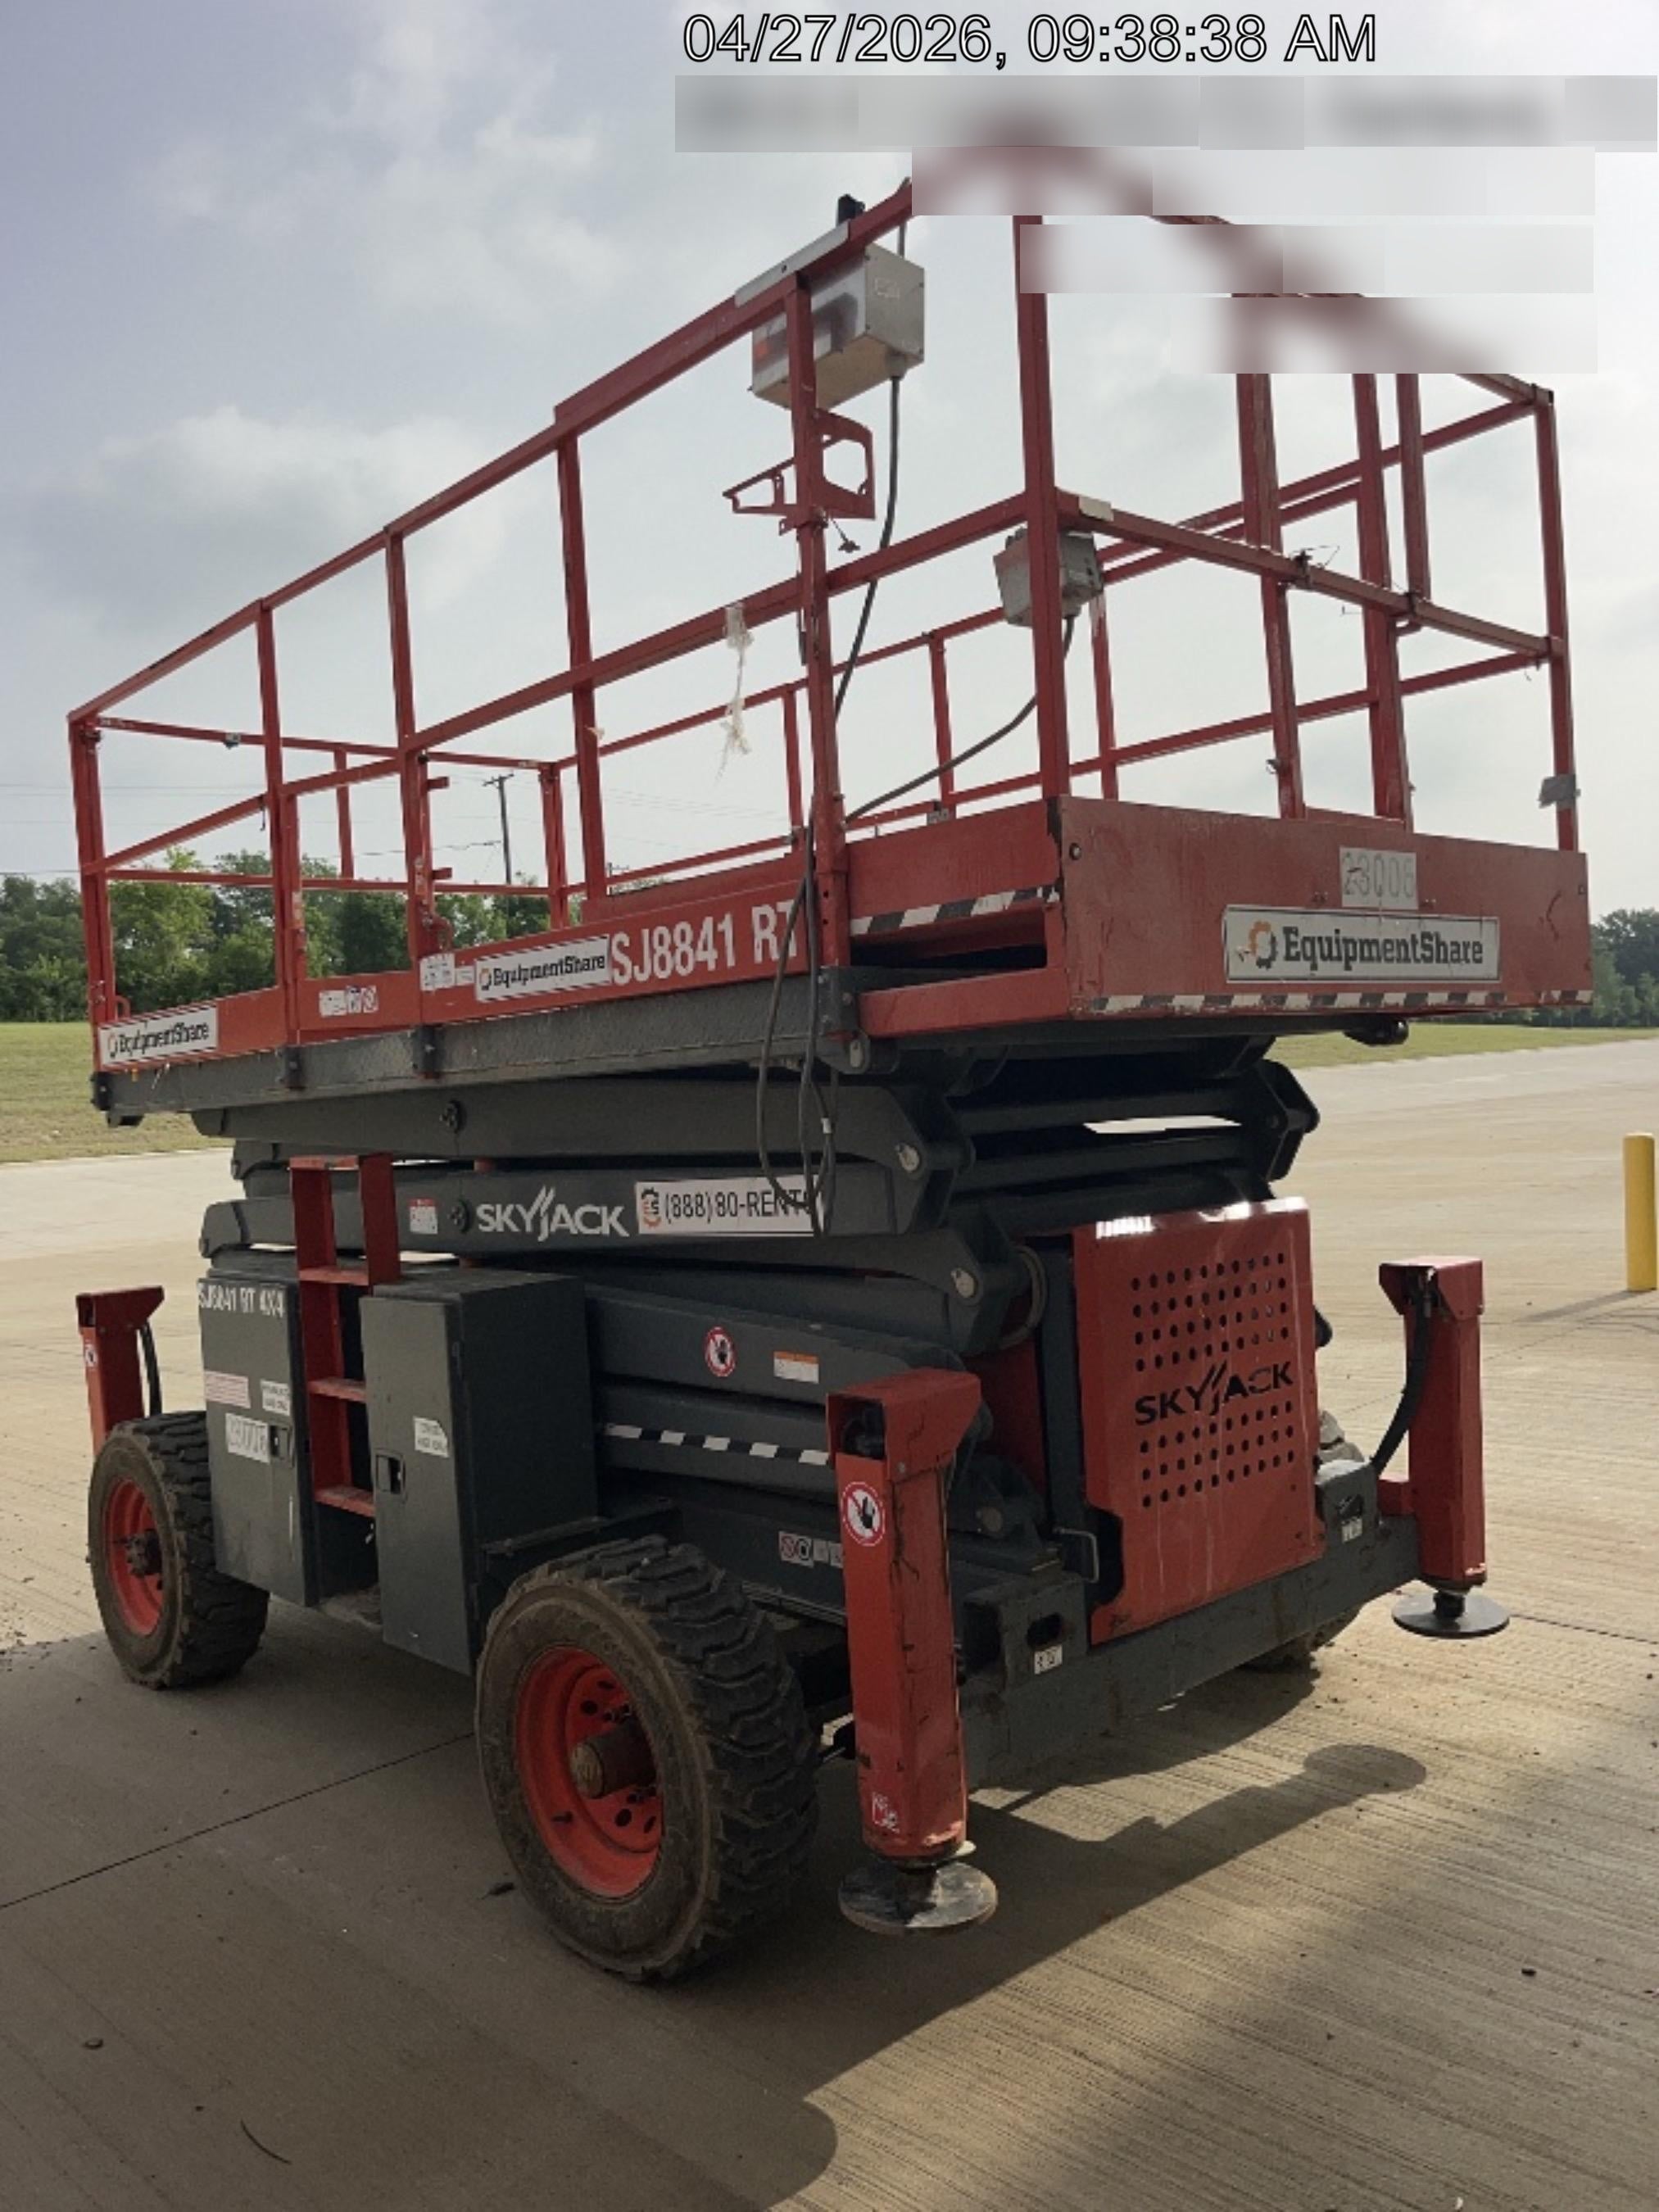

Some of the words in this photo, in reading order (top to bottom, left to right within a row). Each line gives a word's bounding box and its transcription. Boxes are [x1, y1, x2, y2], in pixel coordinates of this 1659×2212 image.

[493, 954, 605, 988] EquipmentShare
[611, 913, 735, 986] SJ8841
[751, 899, 797, 964] RT
[1282, 926, 1484, 971] EquipmentShare
[476, 1185, 630, 1242] SKYJACK
[1135, 1360, 1294, 1426] SKYJACK
